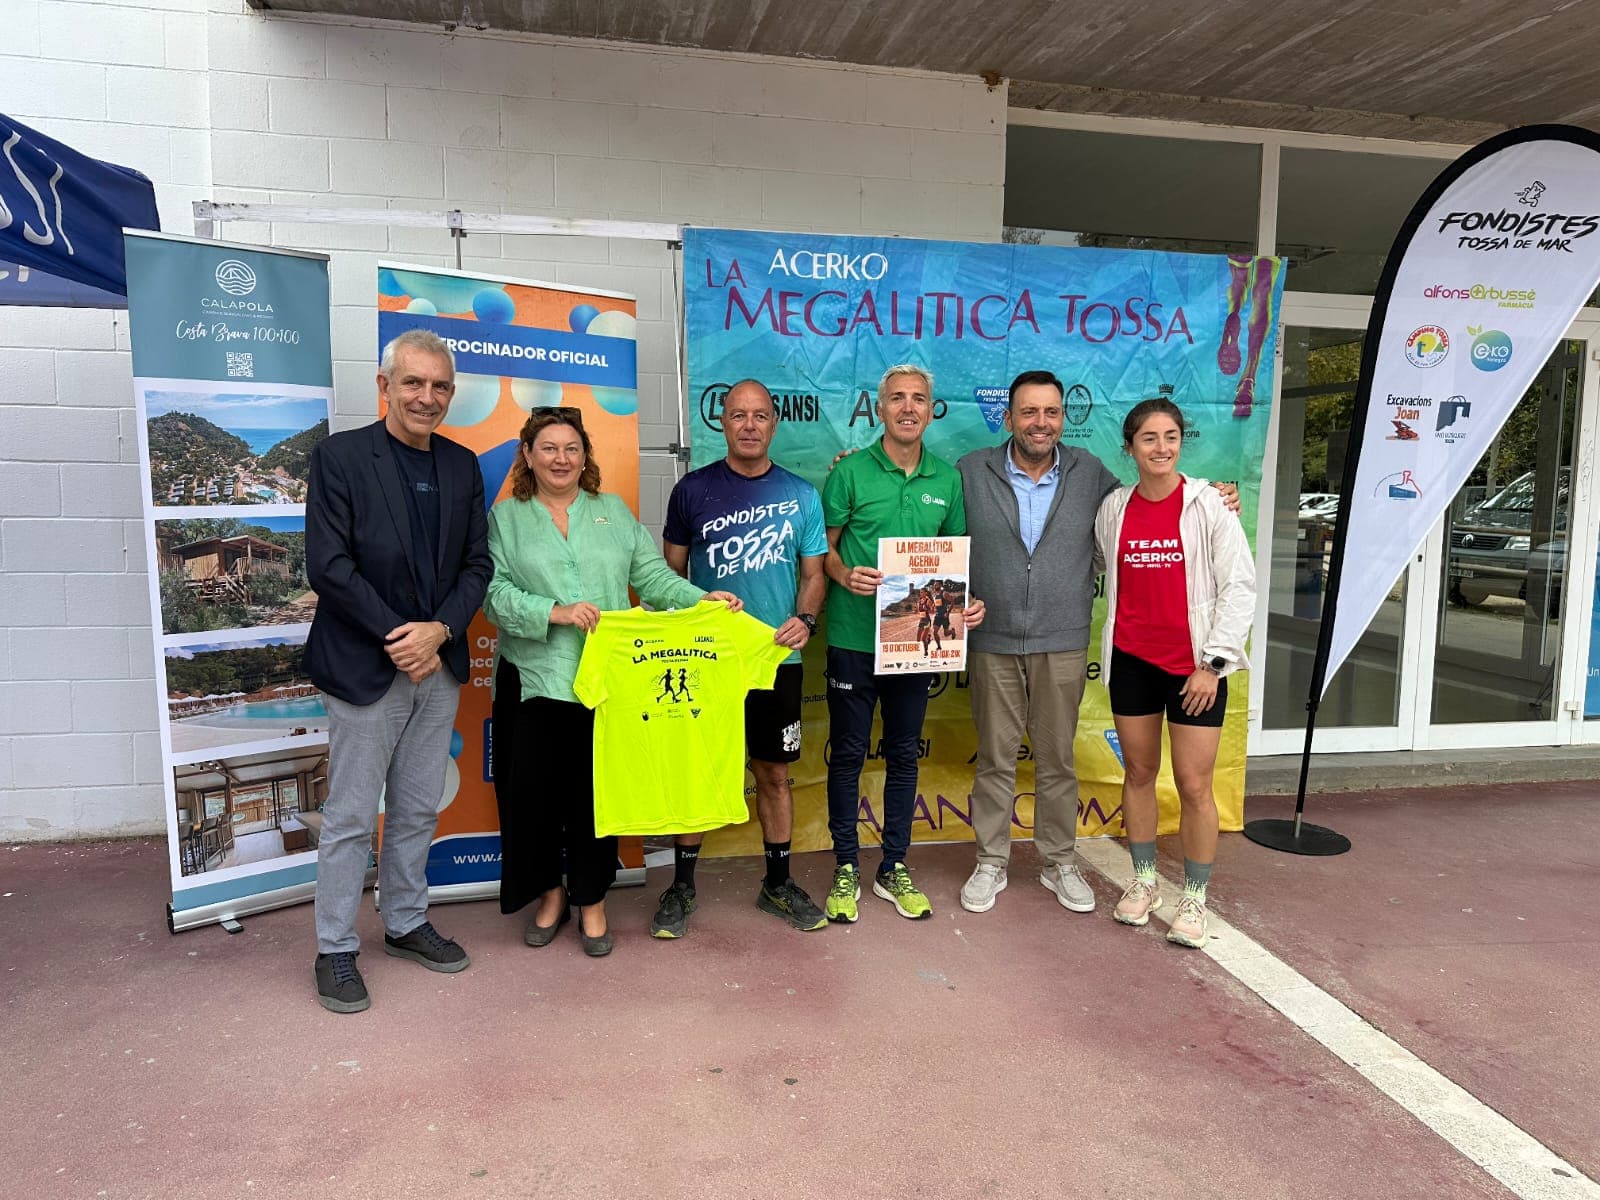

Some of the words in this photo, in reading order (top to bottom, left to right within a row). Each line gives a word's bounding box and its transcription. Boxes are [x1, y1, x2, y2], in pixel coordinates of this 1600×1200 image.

[1438, 208, 1600, 239] FONDISTES
[1458, 236, 1509, 252] TOSSA
[1512, 238, 1532, 249] DE
[1537, 238, 1573, 253] MAR
[706, 258, 747, 289] LA
[768, 248, 888, 281] ACERKO
[201, 298, 274, 313] CALAPOLA
[724, 286, 1041, 342] MEGALITICA
[1059, 294, 1195, 345] TOSSA
[176, 319, 208, 340] Costa
[211, 322, 251, 342] Brava
[1407, 327, 1435, 347] CAMPING
[549, 349, 609, 368] OFICIAL
[1386, 394, 1432, 407] Excavacions
[1394, 407, 1420, 420] Joan
[702, 500, 799, 540] FONDISTES
[706, 520, 794, 568] TOSSA
[896, 541, 906, 553] LA
[1127, 539, 1178, 549] TEAM
[717, 559, 740, 579] DE
[743, 545, 792, 573] MAR
[909, 555, 940, 567] ACERKO
[1124, 553, 1183, 563] ACERKO
[632, 654, 648, 664] LA
[650, 648, 718, 661] MEGALITICA
